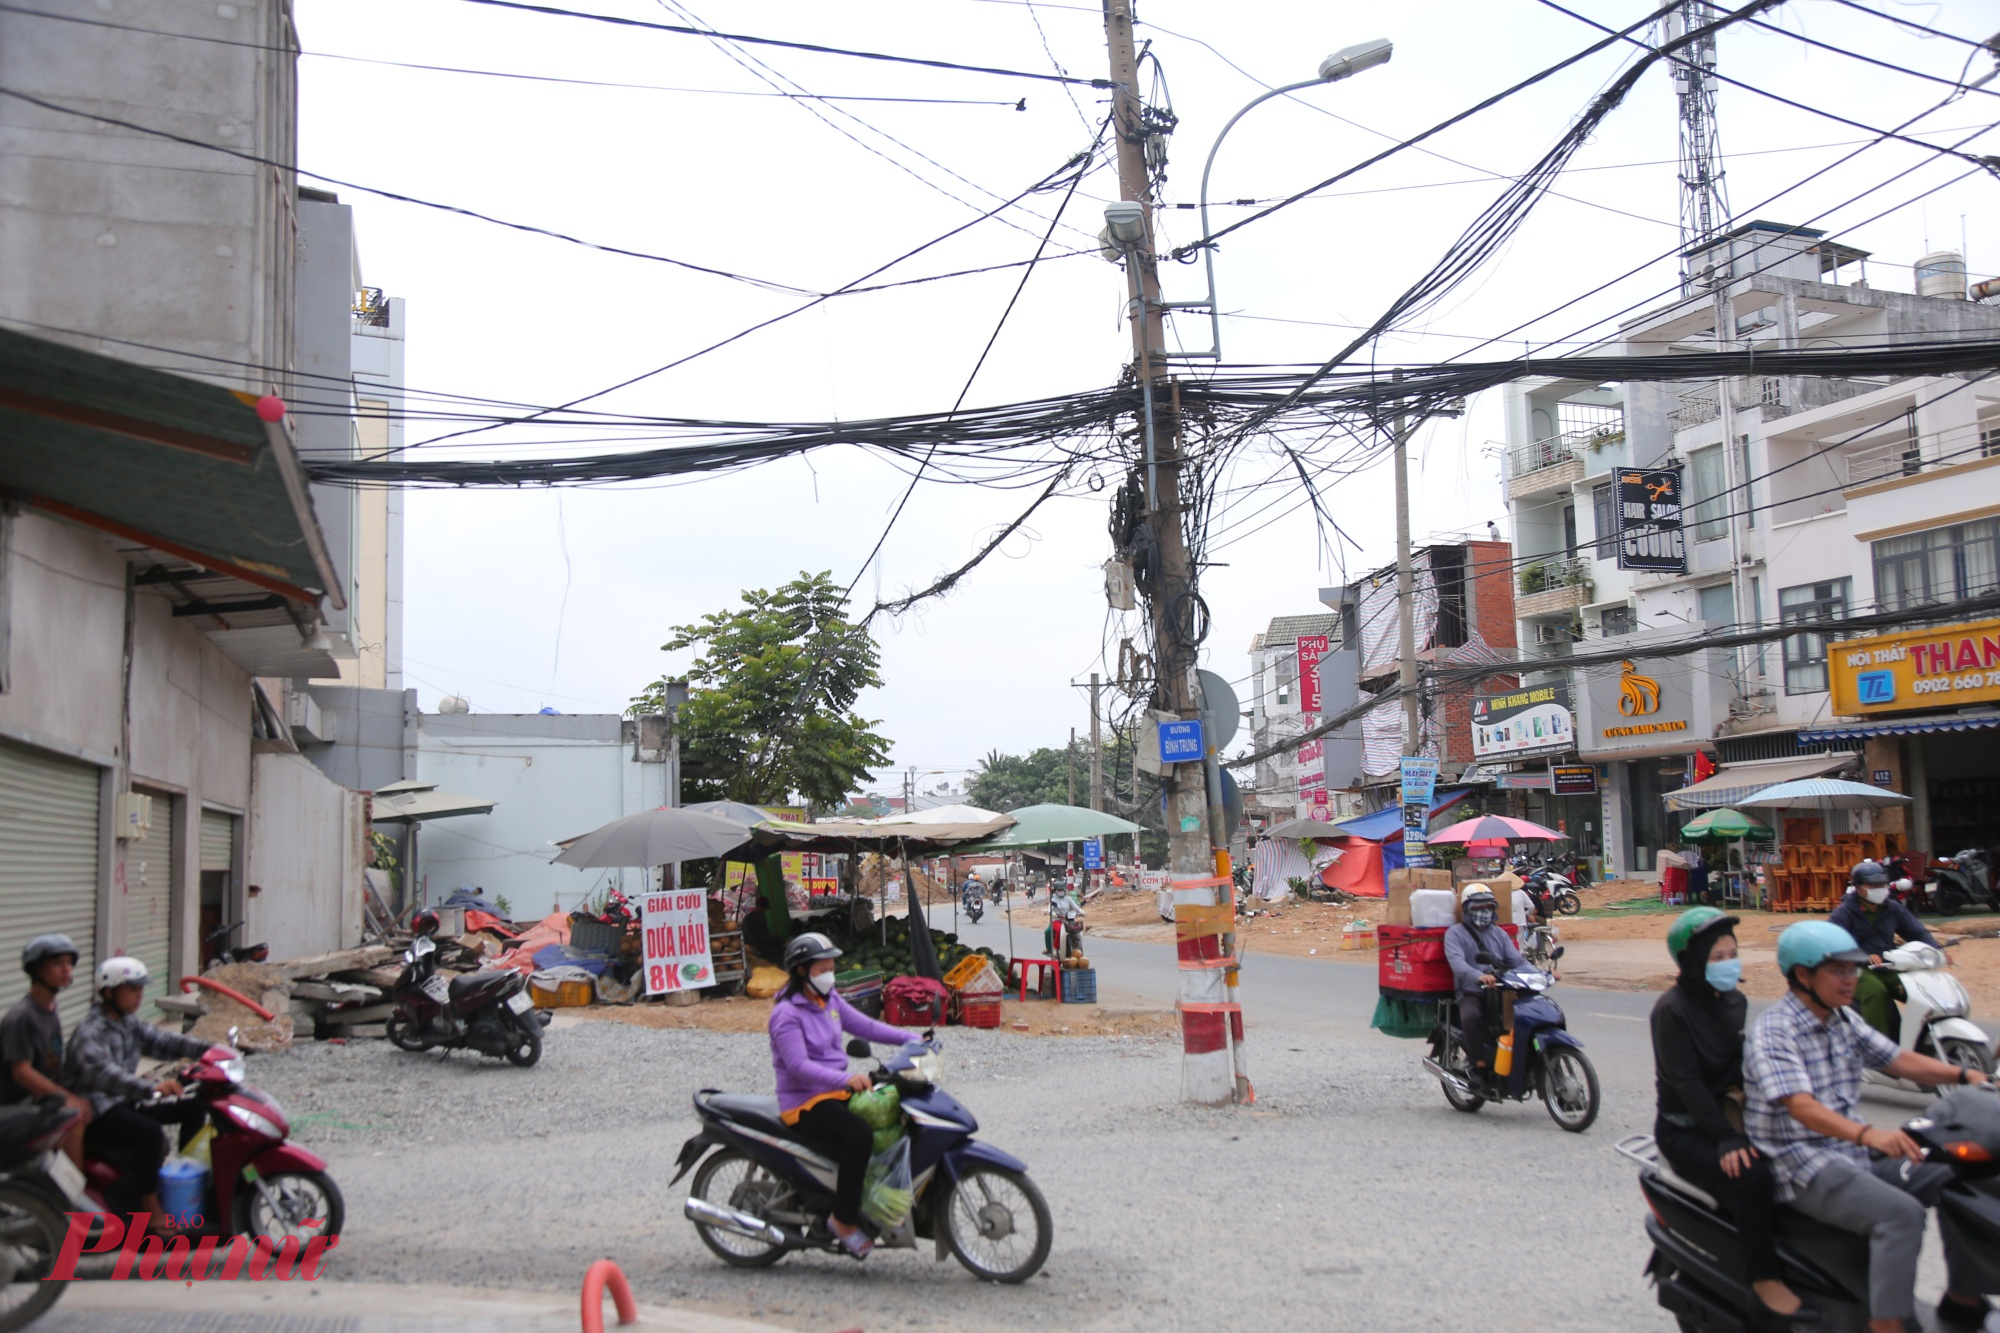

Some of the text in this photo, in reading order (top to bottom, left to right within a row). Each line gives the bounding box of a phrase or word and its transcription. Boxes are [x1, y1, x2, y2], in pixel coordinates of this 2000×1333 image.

[1623, 502, 1680, 520] HAIR SALON
[1624, 524, 1683, 558] CƯỜNG
[1301, 640, 1325, 651] PHỤ
[1847, 641, 1906, 670] NỘI THẤT
[1909, 634, 2000, 676] THAN
[1912, 677, 1950, 695] 0902
[1953, 673, 1984, 690] 660
[1490, 687, 1555, 711] MINH KHANG MOBILE
[1632, 723, 1656, 735] HAIR
[1656, 720, 1687, 732] SALON
[1874, 771, 1890, 780] 412
[647, 893, 702, 914] GIẢI CỨU
[646, 913, 706, 960] DƯA HẤU
[650, 963, 682, 993] 8K
